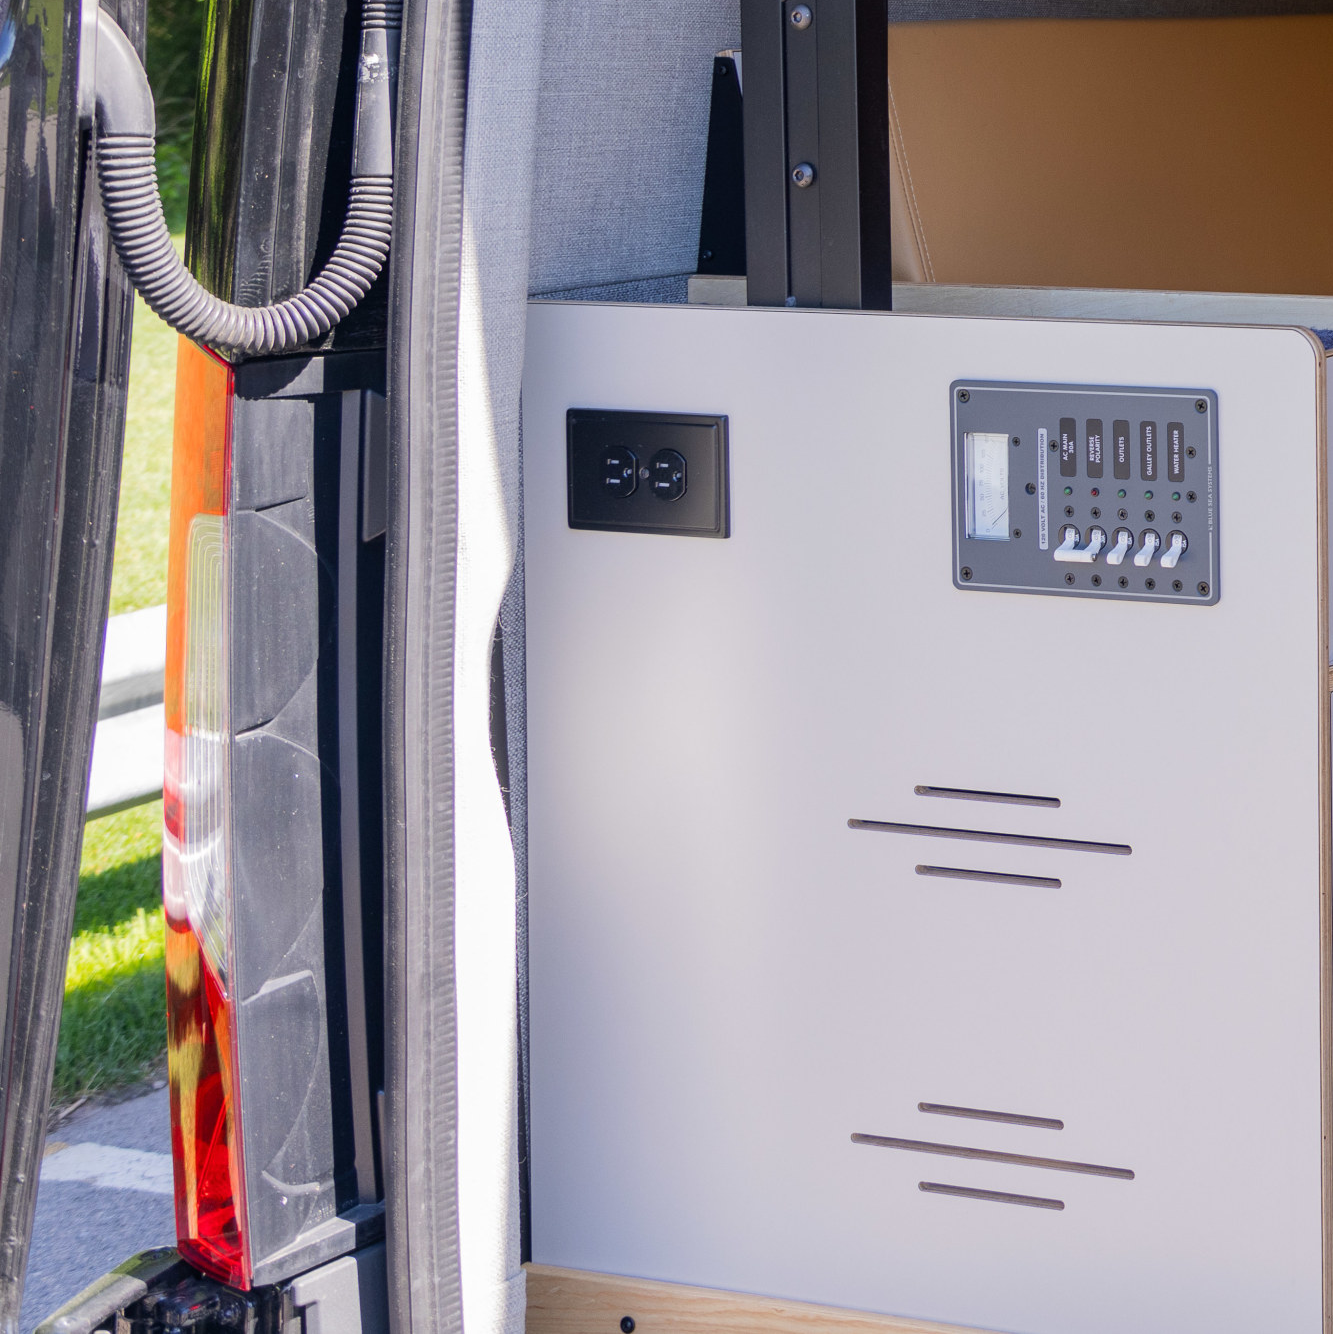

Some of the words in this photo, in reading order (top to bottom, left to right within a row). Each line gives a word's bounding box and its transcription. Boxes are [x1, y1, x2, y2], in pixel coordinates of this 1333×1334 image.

[1063, 451, 1068, 461] AC
[1040, 481, 1045, 490] HZ
[1040, 504, 1046, 513] AC
